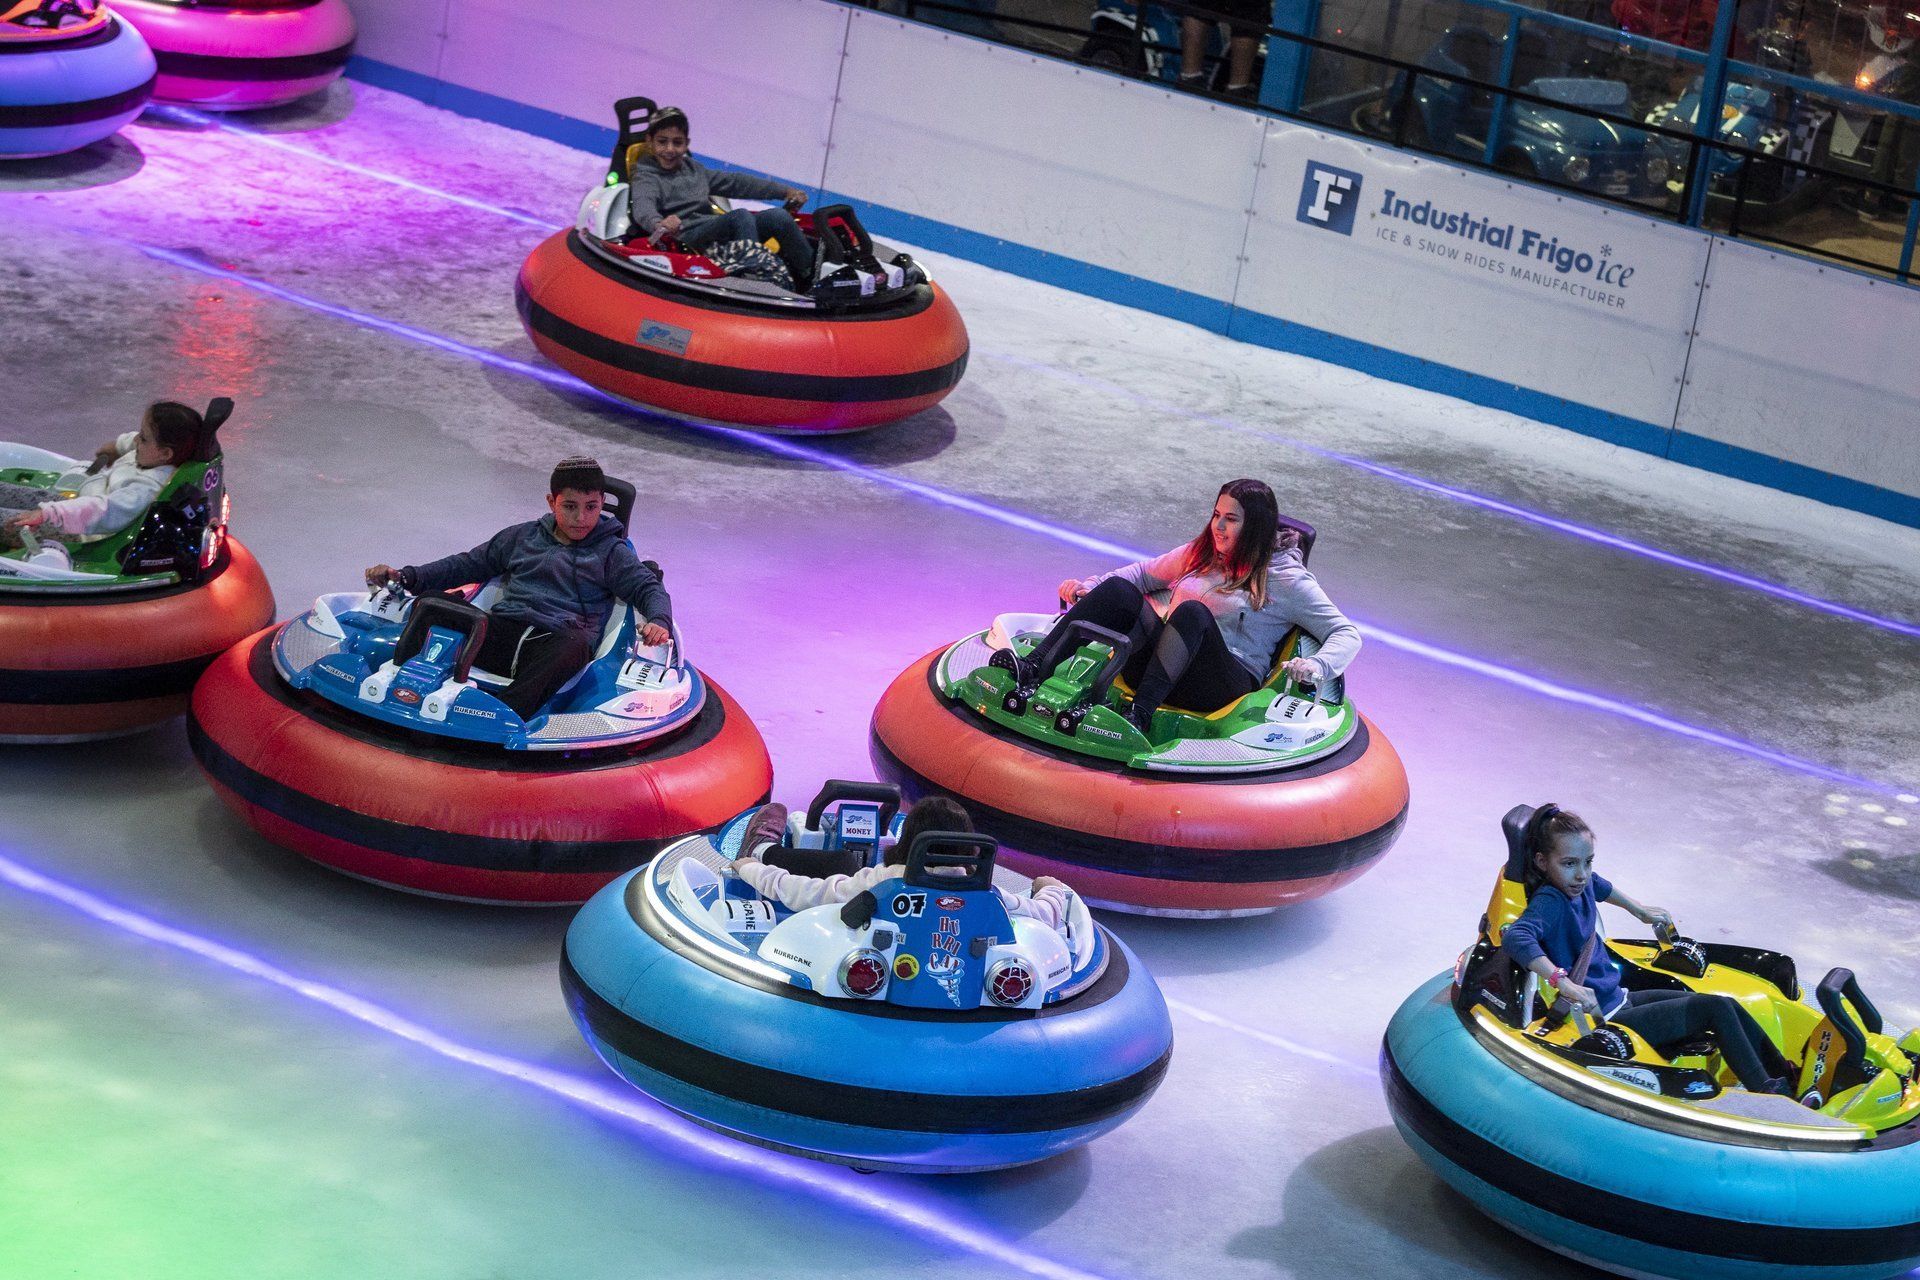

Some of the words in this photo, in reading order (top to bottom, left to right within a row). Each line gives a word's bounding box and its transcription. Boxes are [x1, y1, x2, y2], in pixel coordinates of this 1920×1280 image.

[1380, 189, 1514, 250] Industrial
[1518, 229, 1593, 273] Frigo
[1596, 246, 1634, 288] ice
[1376, 227, 1398, 242] ICE
[1403, 235, 1412, 246] &
[1418, 239, 1459, 260] SNOW
[1464, 252, 1505, 274] RIDES
[1510, 266, 1626, 309] MANUFACTURER
[454, 705, 496, 719] HURRICANE
[1083, 724, 1122, 740] HURRICANE
[845, 827, 872, 835] MONEY
[892, 893, 927, 918] 07
[774, 948, 812, 968] HURRICANE
[1813, 1030, 1832, 1084] HURRI
[1612, 1069, 1657, 1090] HURRICANE
